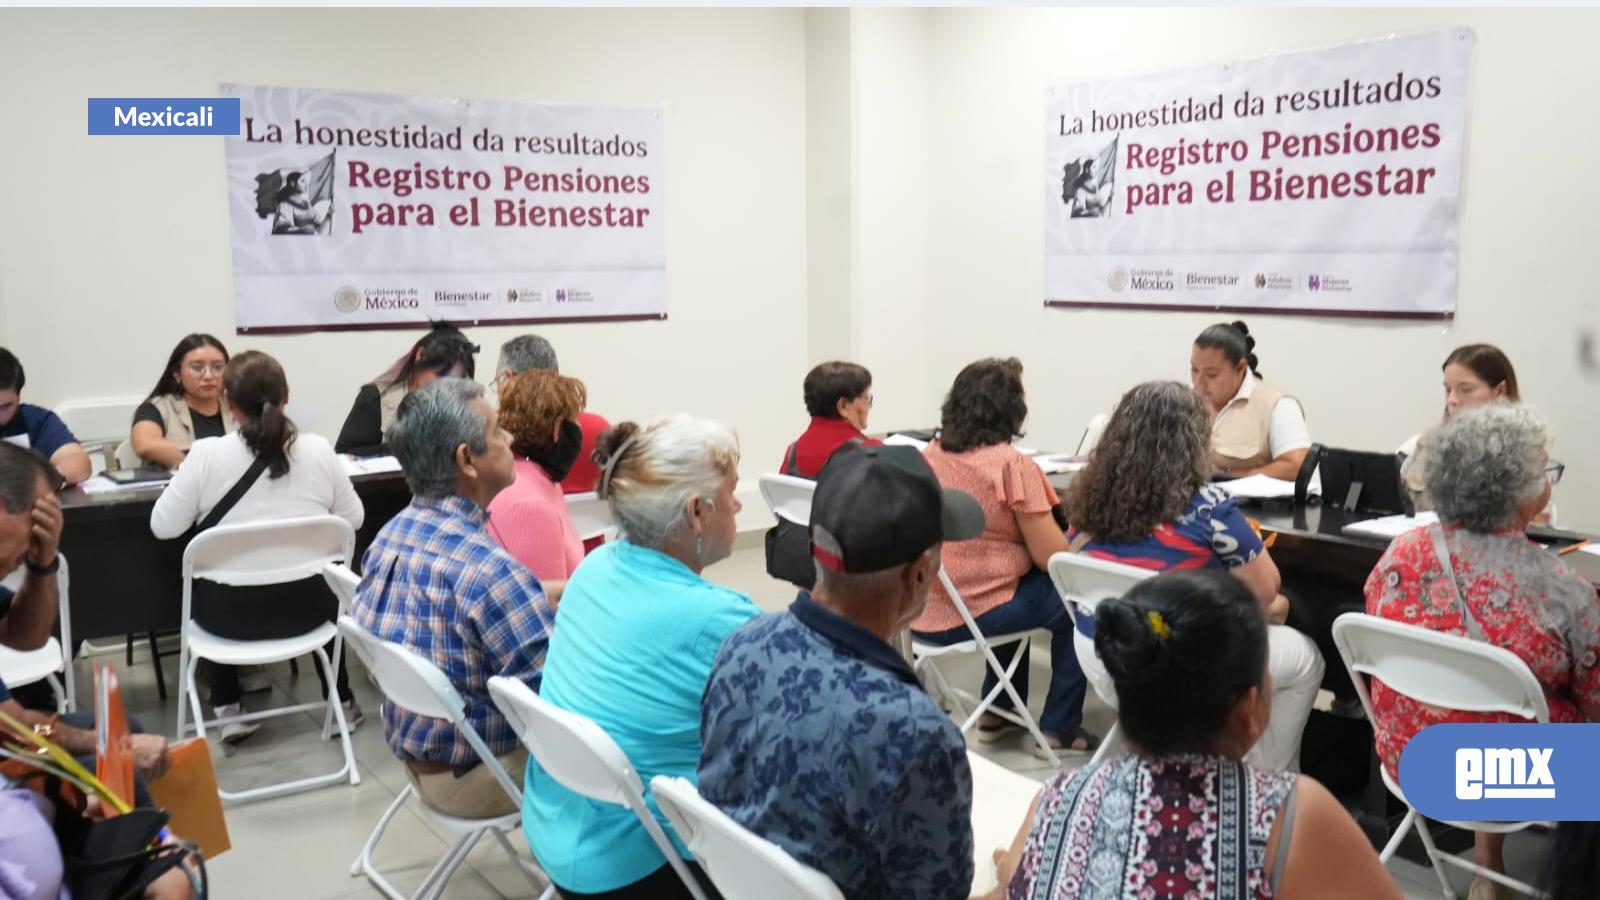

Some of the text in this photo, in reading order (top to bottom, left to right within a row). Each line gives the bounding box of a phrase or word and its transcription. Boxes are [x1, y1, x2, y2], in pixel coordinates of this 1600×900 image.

[1059, 71, 1442, 136] La honestidad da resultados
[245, 118, 649, 158] La honestidad da resultados
[1125, 122, 1441, 175] Registro Pensiones
[347, 160, 651, 197] Registro Pensiones
[1125, 162, 1436, 215] para el Bienestar
[351, 197, 651, 234] para el Bienestar
[434, 290, 491, 302] Bienestar
[1131, 276, 1174, 291] México
[1186, 273, 1240, 286] Bienestar
[365, 296, 419, 310] México
